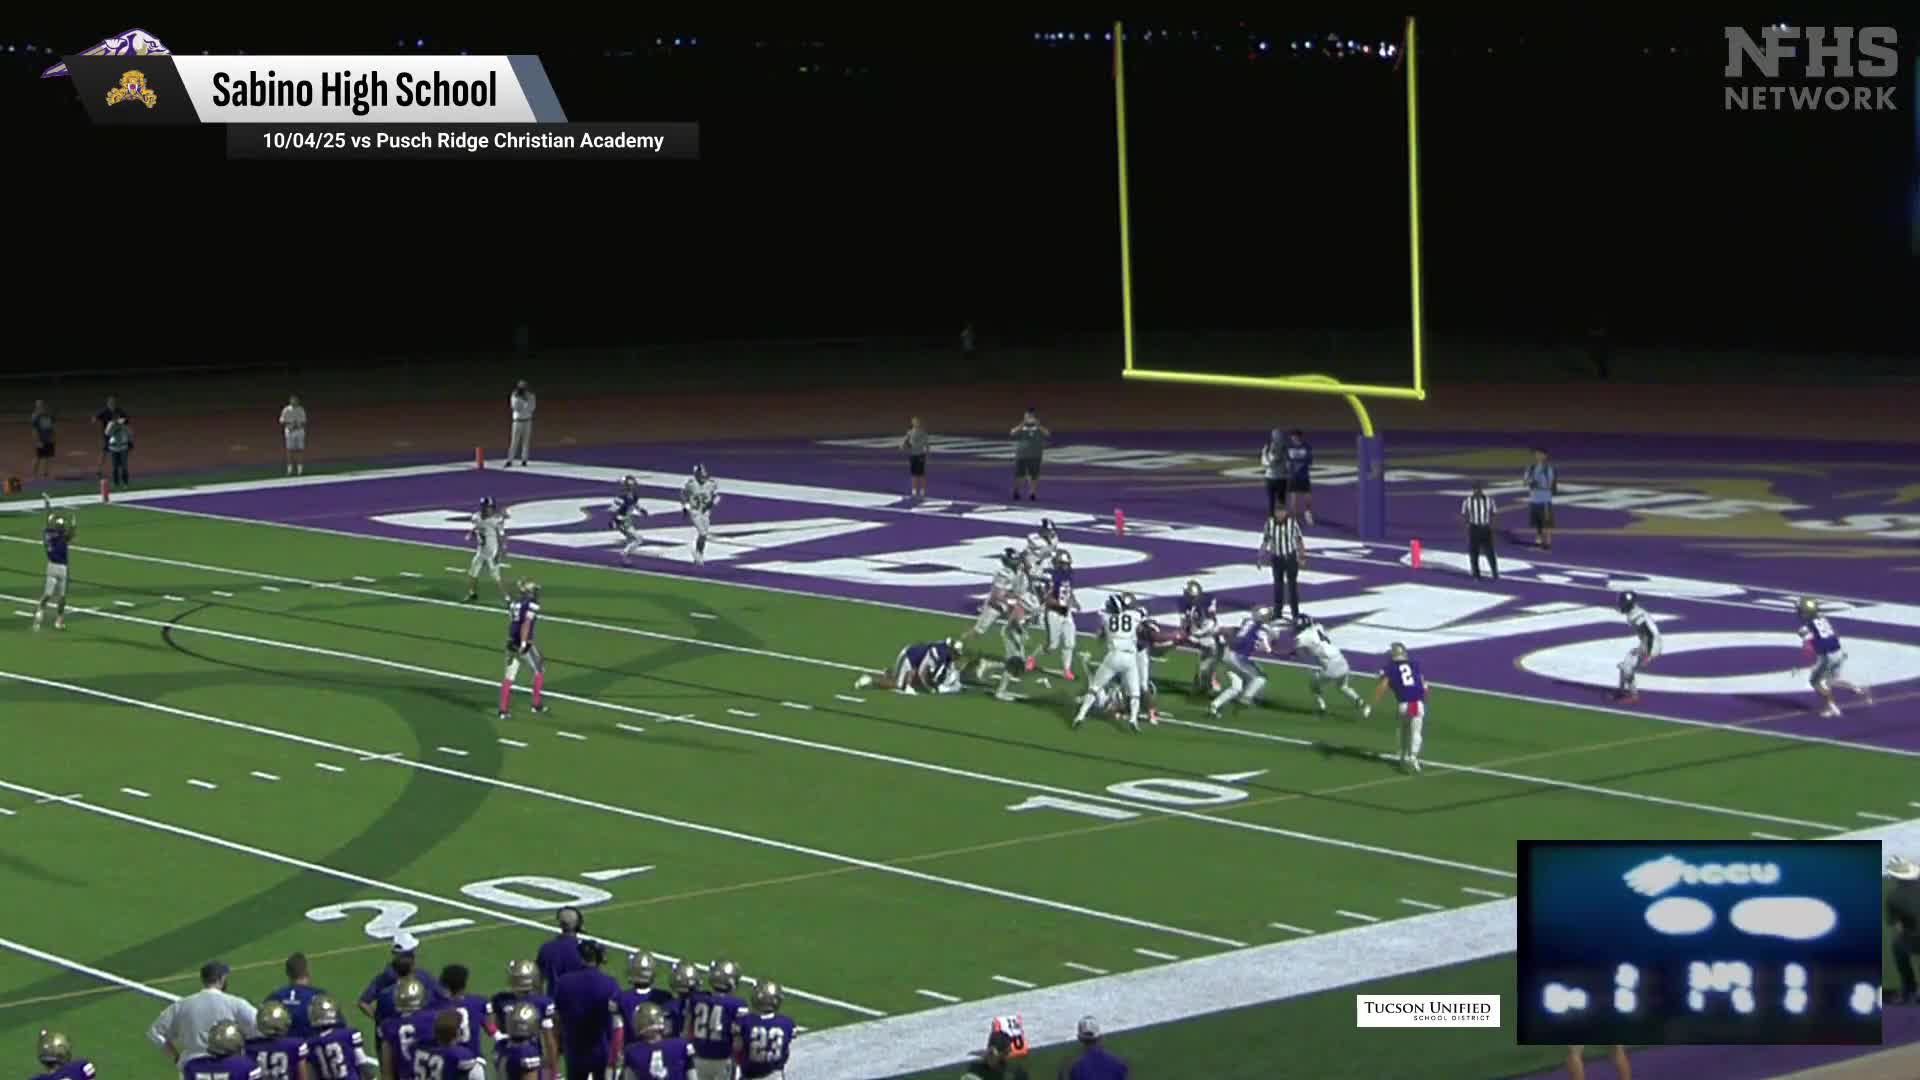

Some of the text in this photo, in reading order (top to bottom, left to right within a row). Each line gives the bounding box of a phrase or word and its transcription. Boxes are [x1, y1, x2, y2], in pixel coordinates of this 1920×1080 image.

[1108, 615, 1132, 632] 88
[1399, 664, 1415, 686] 2
[1004, 777, 1250, 820] 10
[305, 875, 613, 940] 20
[694, 1003, 723, 1040] 24
[316, 1043, 348, 1079] 12
[750, 1026, 785, 1063] 23
[650, 1050, 668, 1079] 4
